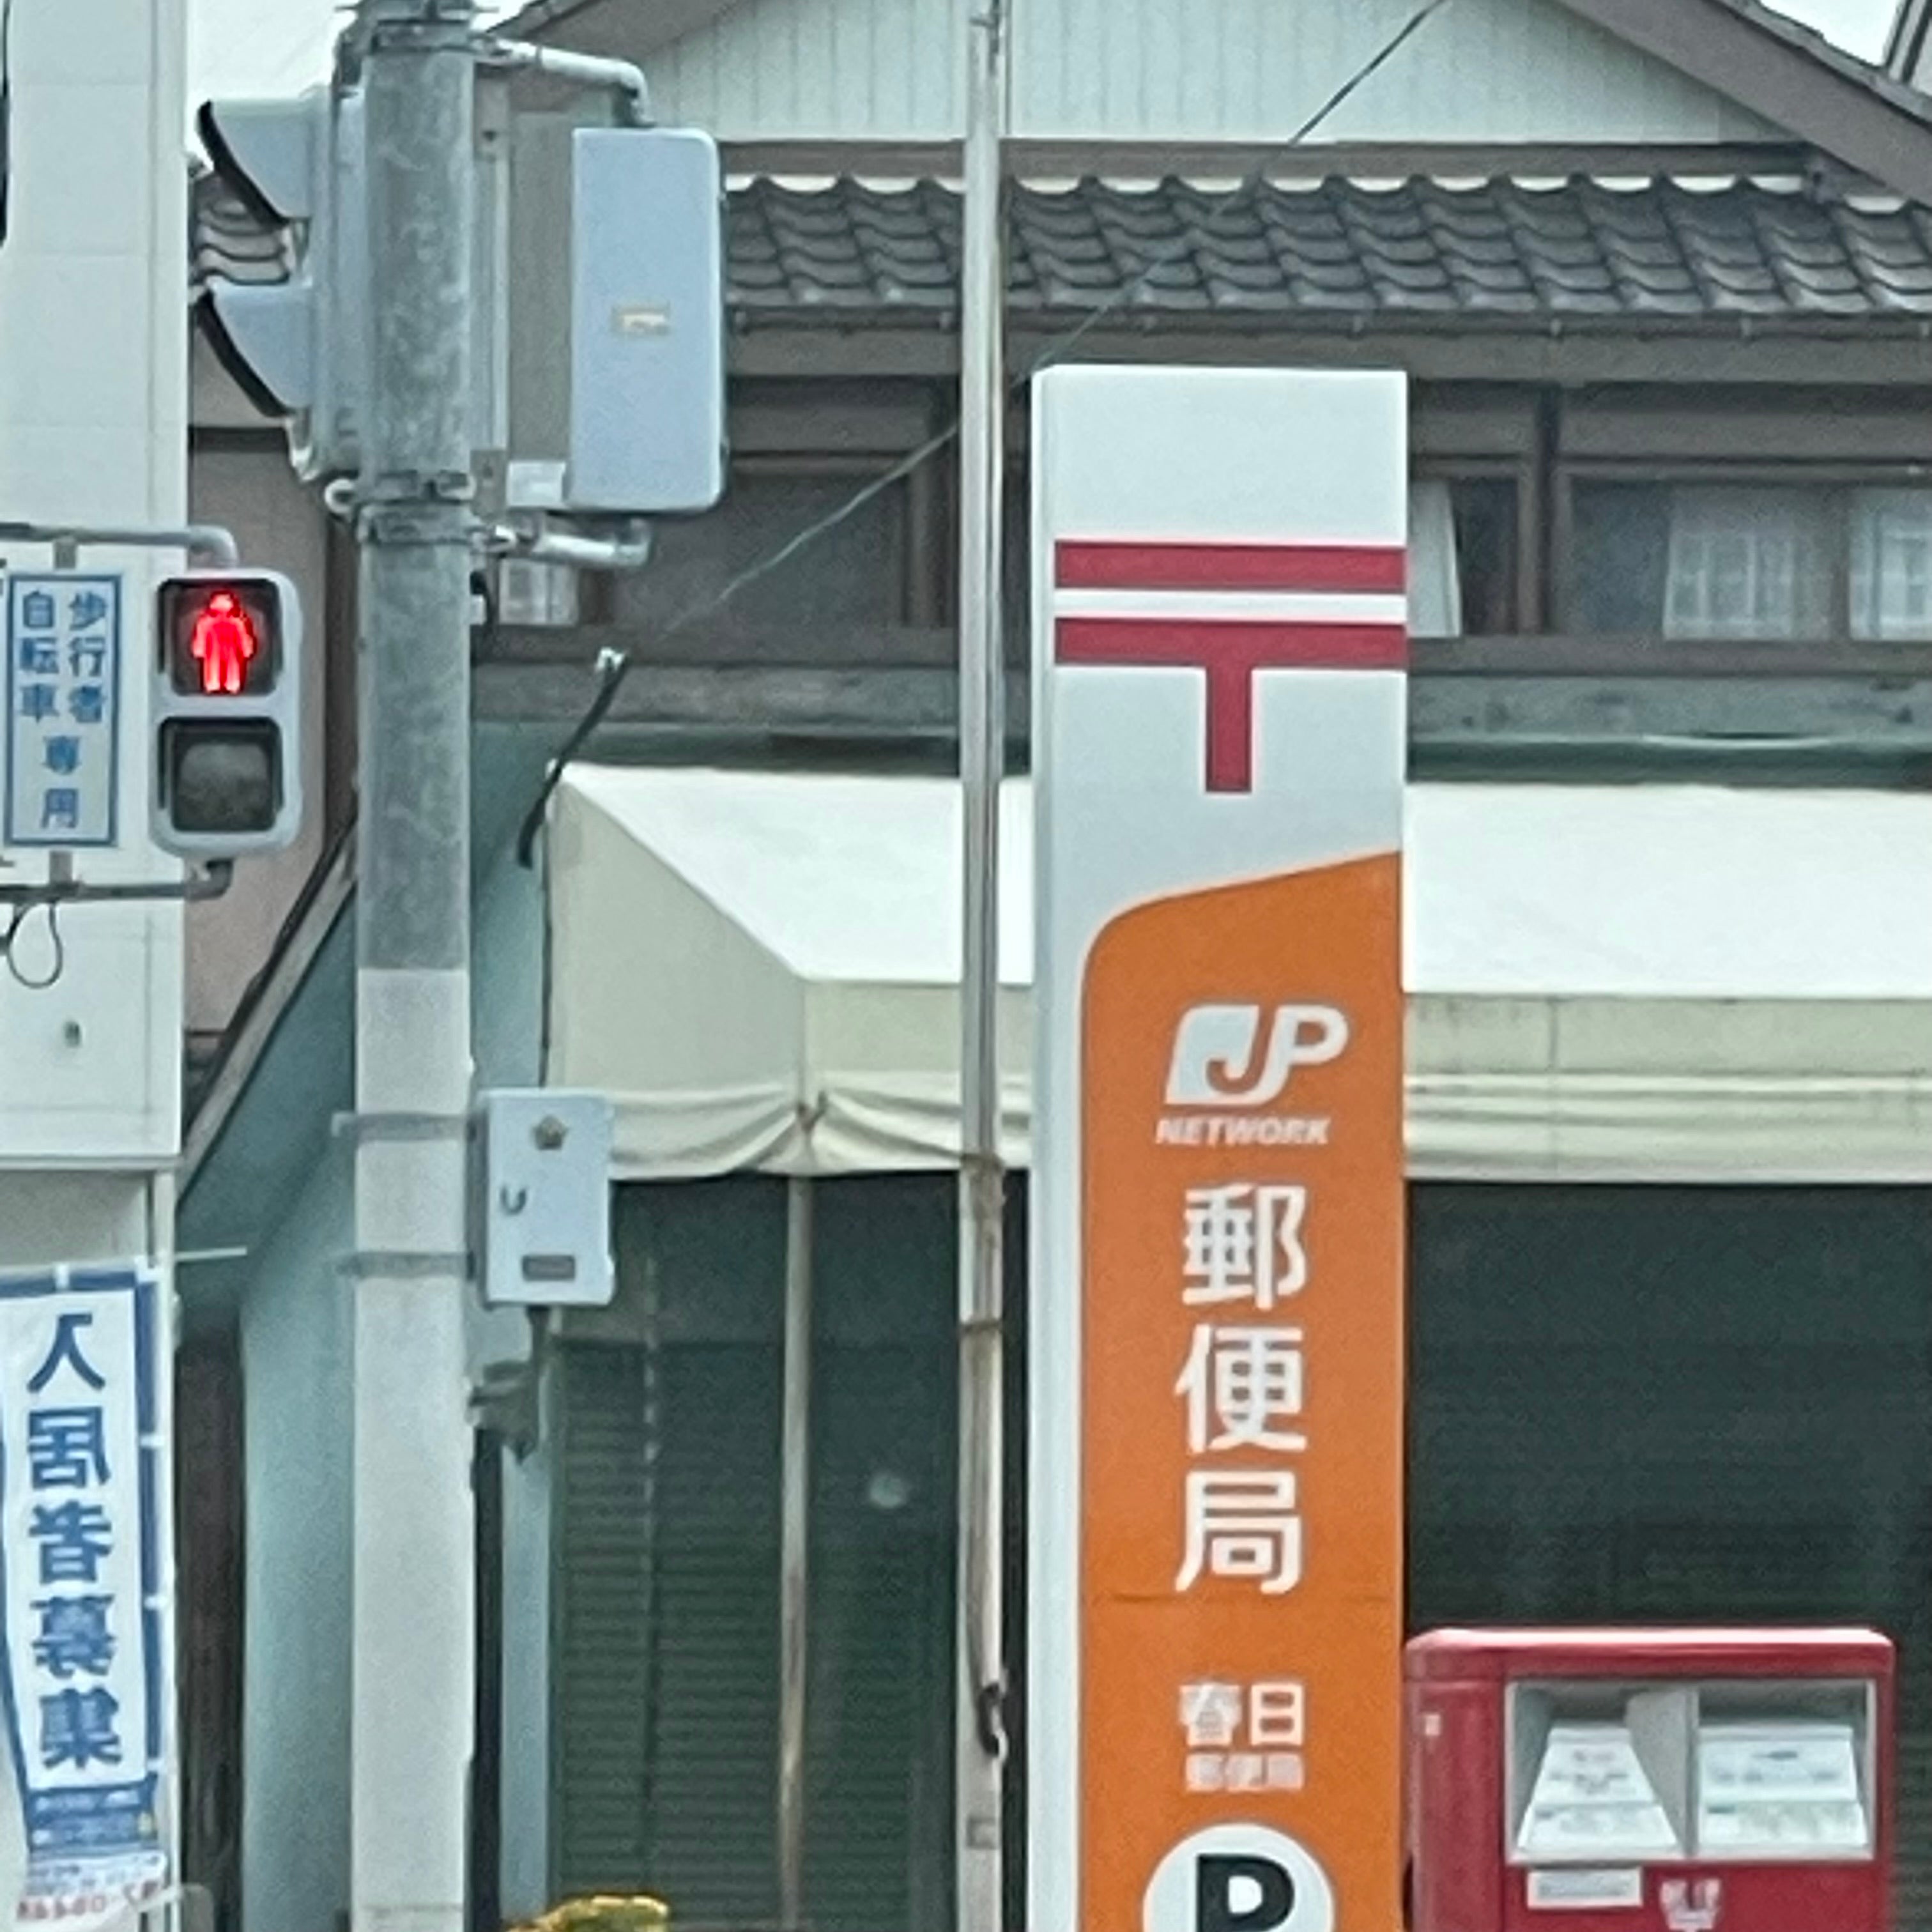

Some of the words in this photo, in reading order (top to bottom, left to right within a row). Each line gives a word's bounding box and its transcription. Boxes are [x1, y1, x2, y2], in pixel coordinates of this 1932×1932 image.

[1165, 1004, 1350, 1105] JP
[1154, 1116, 1331, 1146] NETWORK
[1174, 1182, 1308, 1593] 郵便局
[1195, 1853, 1296, 1932] P
